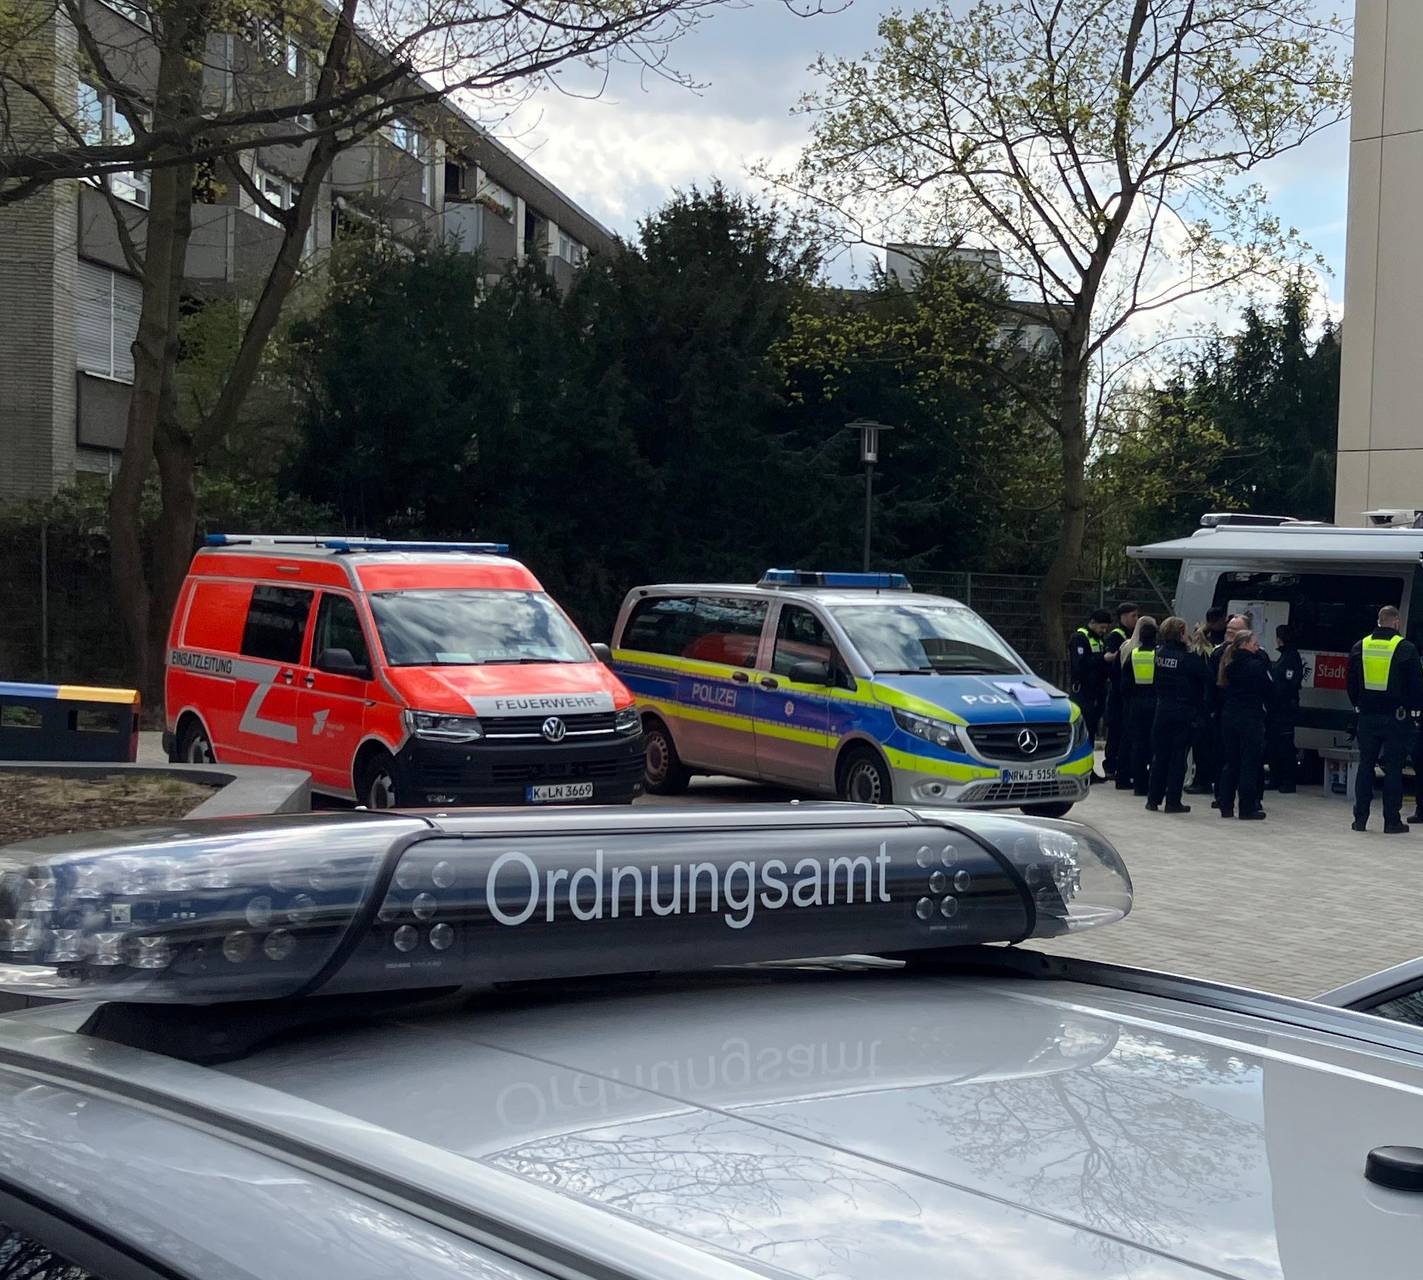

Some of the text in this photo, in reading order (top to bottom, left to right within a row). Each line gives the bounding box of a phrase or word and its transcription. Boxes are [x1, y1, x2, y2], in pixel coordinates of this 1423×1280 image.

[172, 651, 232, 673] EINSATZLEITUNG
[1317, 664, 1346, 679] Stadt
[691, 683, 738, 707] POLIZEI
[961, 694, 1011, 705] POL
[495, 697, 599, 710] FEUERWEHR
[1008, 771, 1024, 781] NRW
[533, 784, 592, 799] K LN 3669
[486, 841, 892, 928] Ordnungsamt
